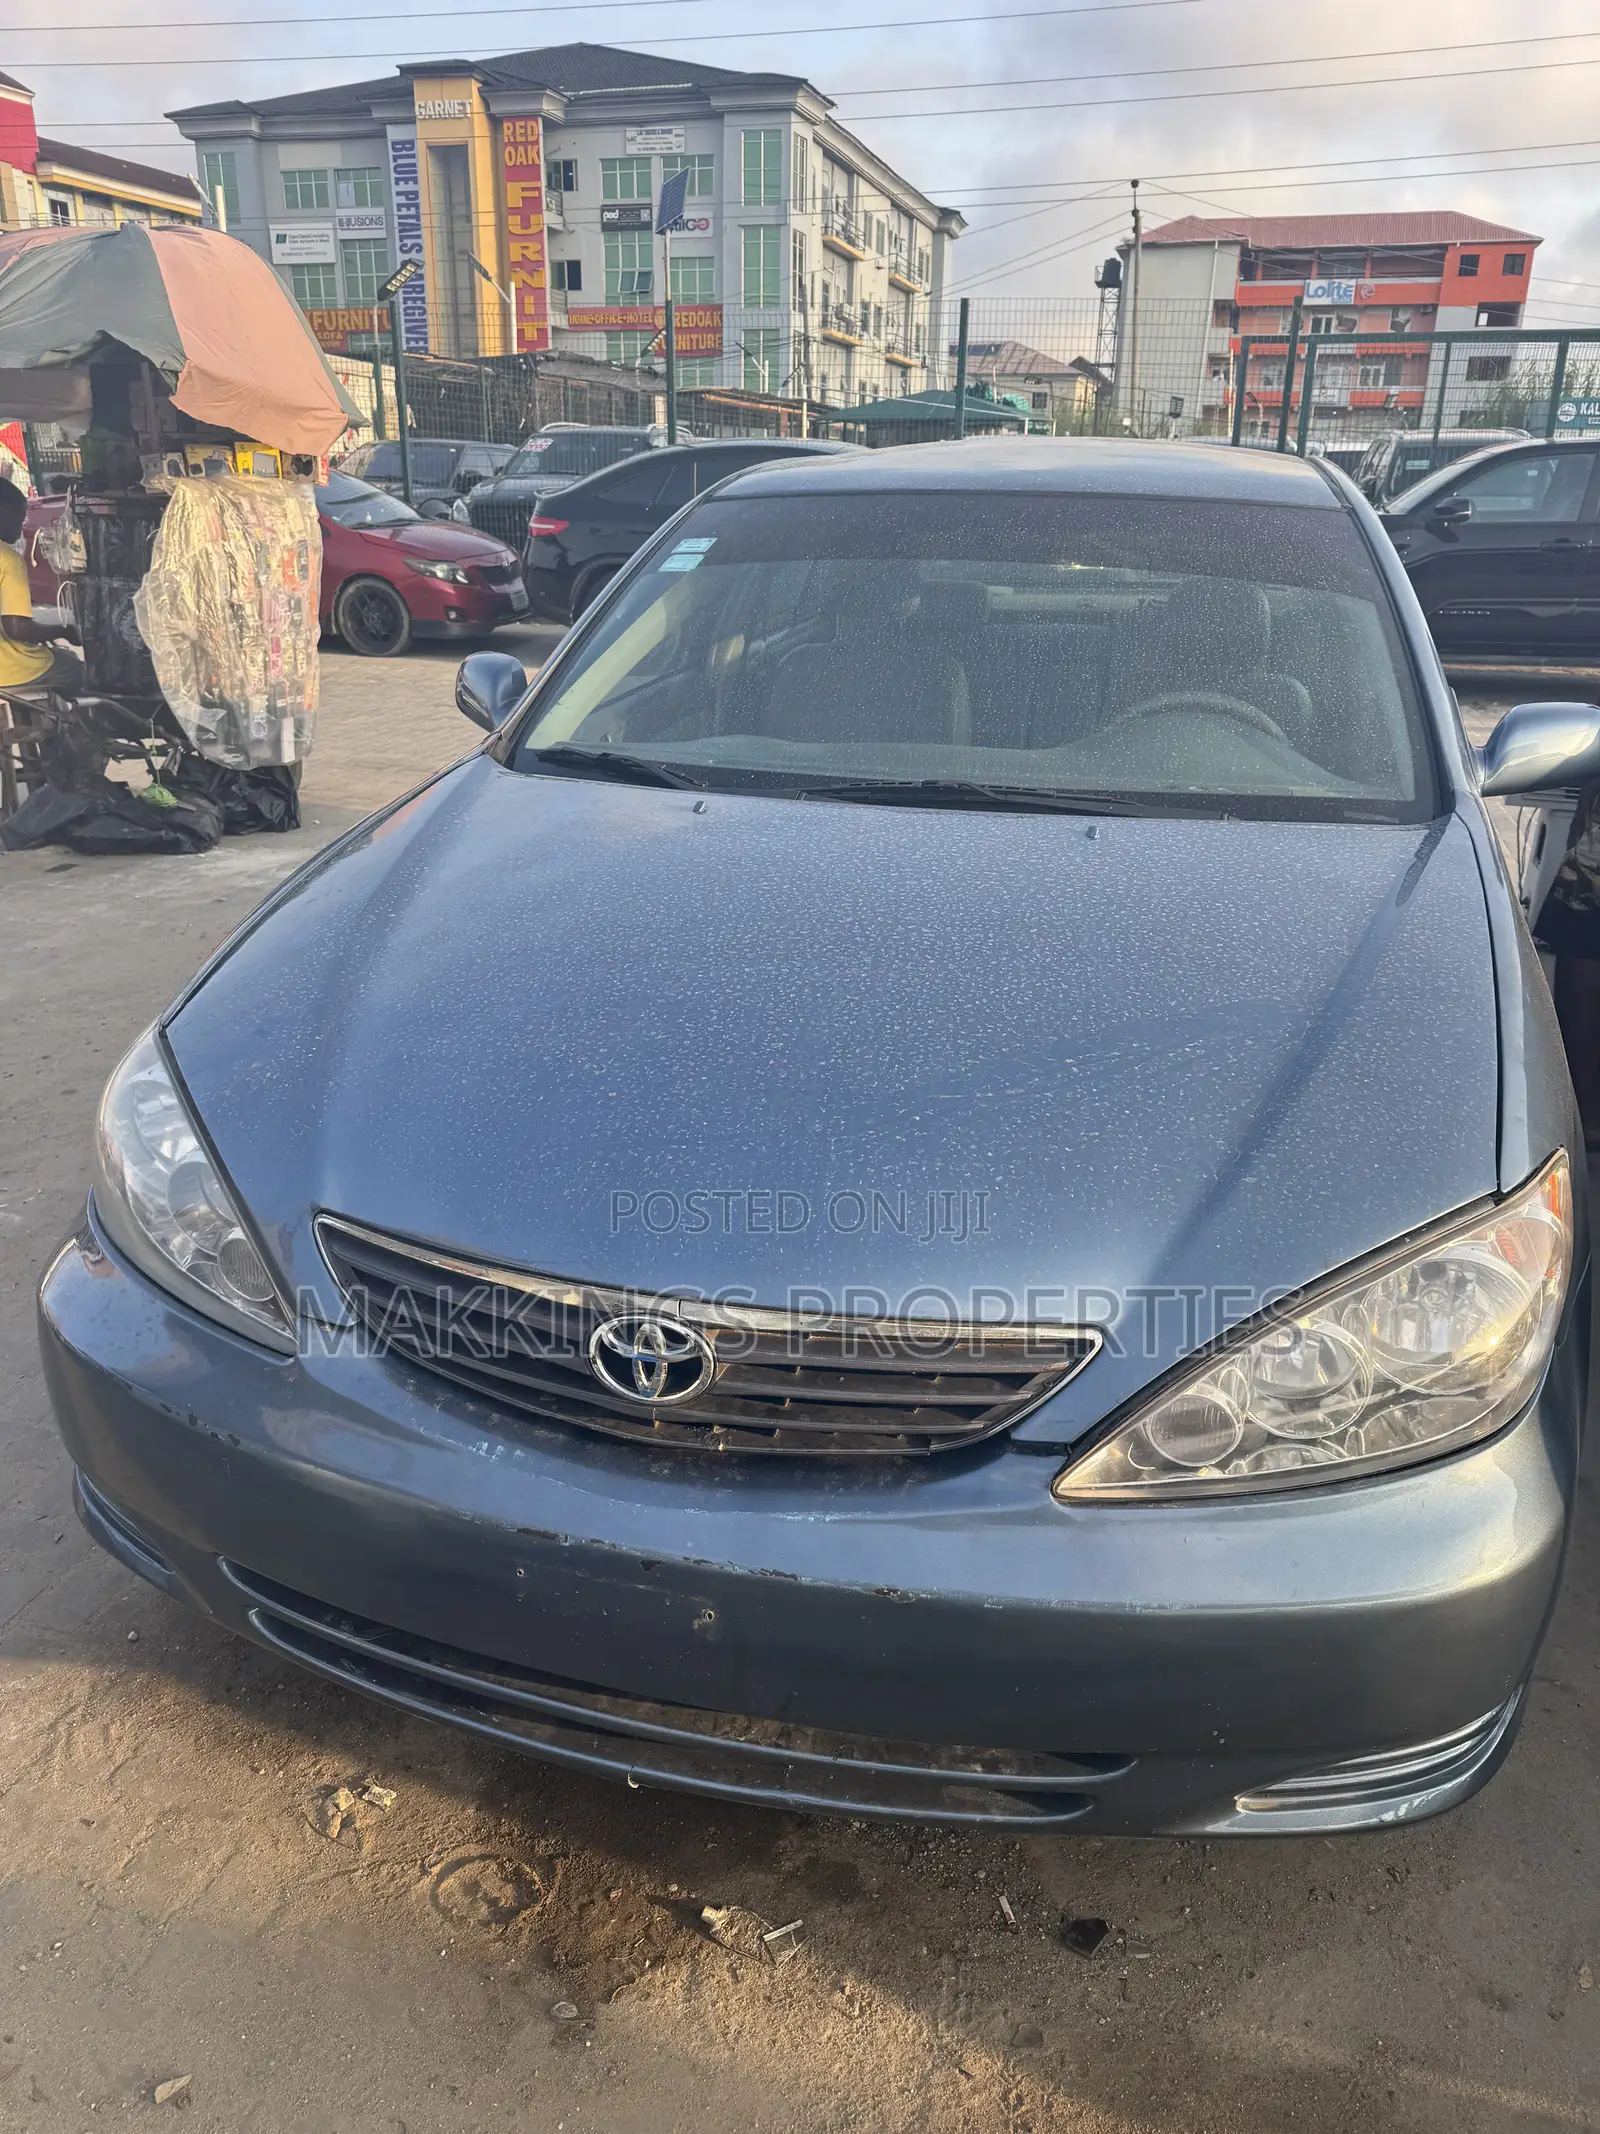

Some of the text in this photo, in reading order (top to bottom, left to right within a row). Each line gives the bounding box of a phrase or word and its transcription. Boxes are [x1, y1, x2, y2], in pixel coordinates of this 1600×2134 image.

[415, 99, 472, 119] GARNET
[504, 120, 539, 143] RED
[505, 145, 541, 167] OAK
[391, 140, 429, 354] BLUE PETALS AREGIVE
[507, 181, 548, 352] FURNIT
